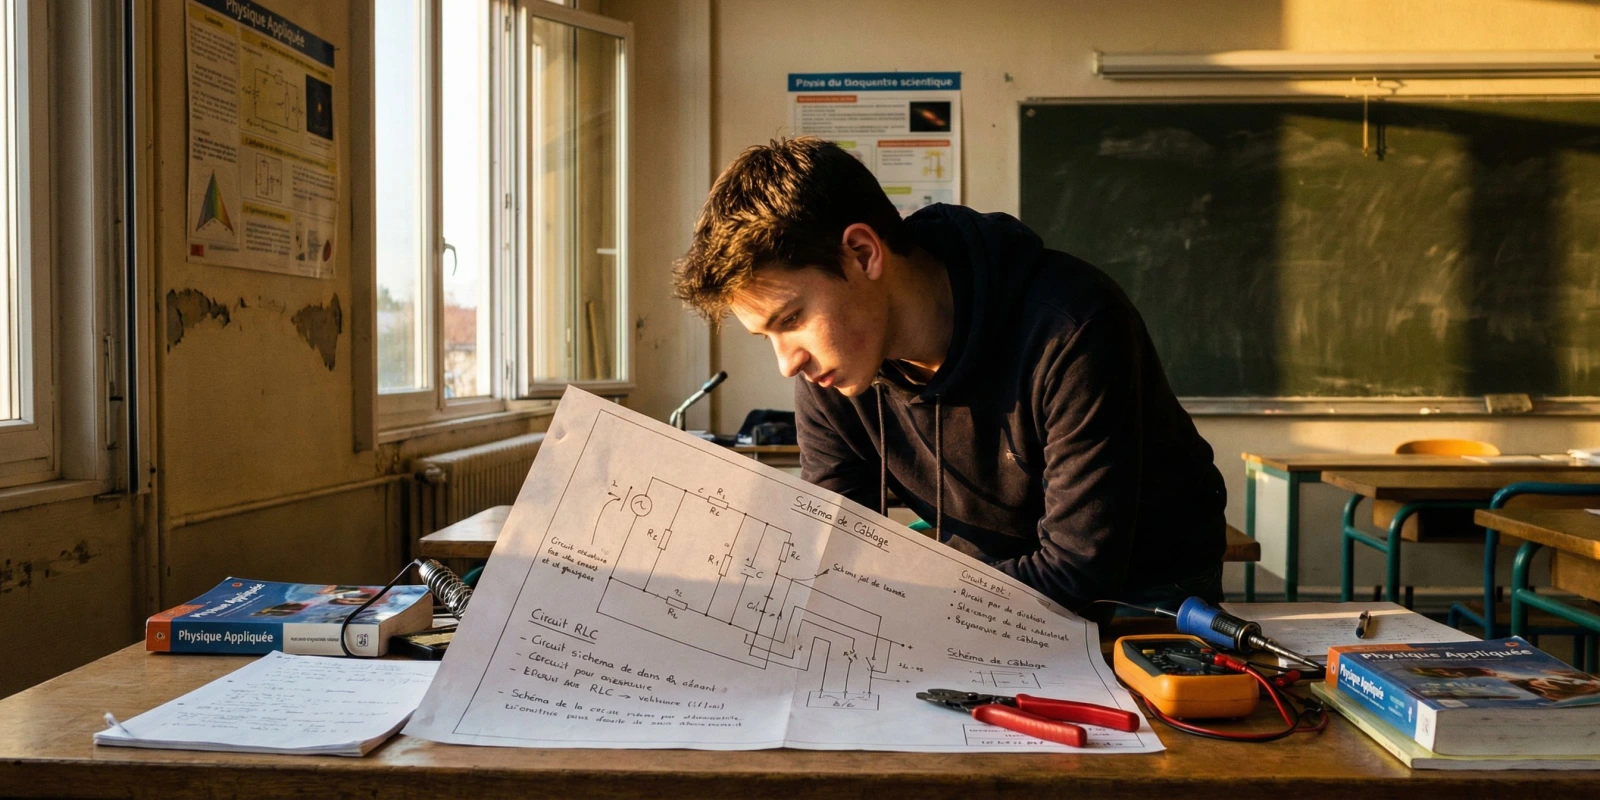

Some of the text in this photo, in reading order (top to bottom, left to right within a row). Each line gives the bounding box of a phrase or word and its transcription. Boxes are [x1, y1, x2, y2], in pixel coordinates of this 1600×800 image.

[226, 0, 266, 28] Physique
[267, 15, 306, 48] Appliquée
[828, 78, 842, 87] du
[793, 495, 889, 549] Schéma de Câblage
[530, 607, 599, 641] Circuit RLC
[178, 629, 274, 645] Physique Appliquée
[531, 634, 567, 652] Circuit
[620, 663, 633, 674] de
[989, 656, 1002, 665] de
[1359, 648, 1534, 660] Physique Appliquée
[510, 688, 550, 705] Schéma
[555, 699, 567, 709] de
[589, 683, 614, 697] RLC
